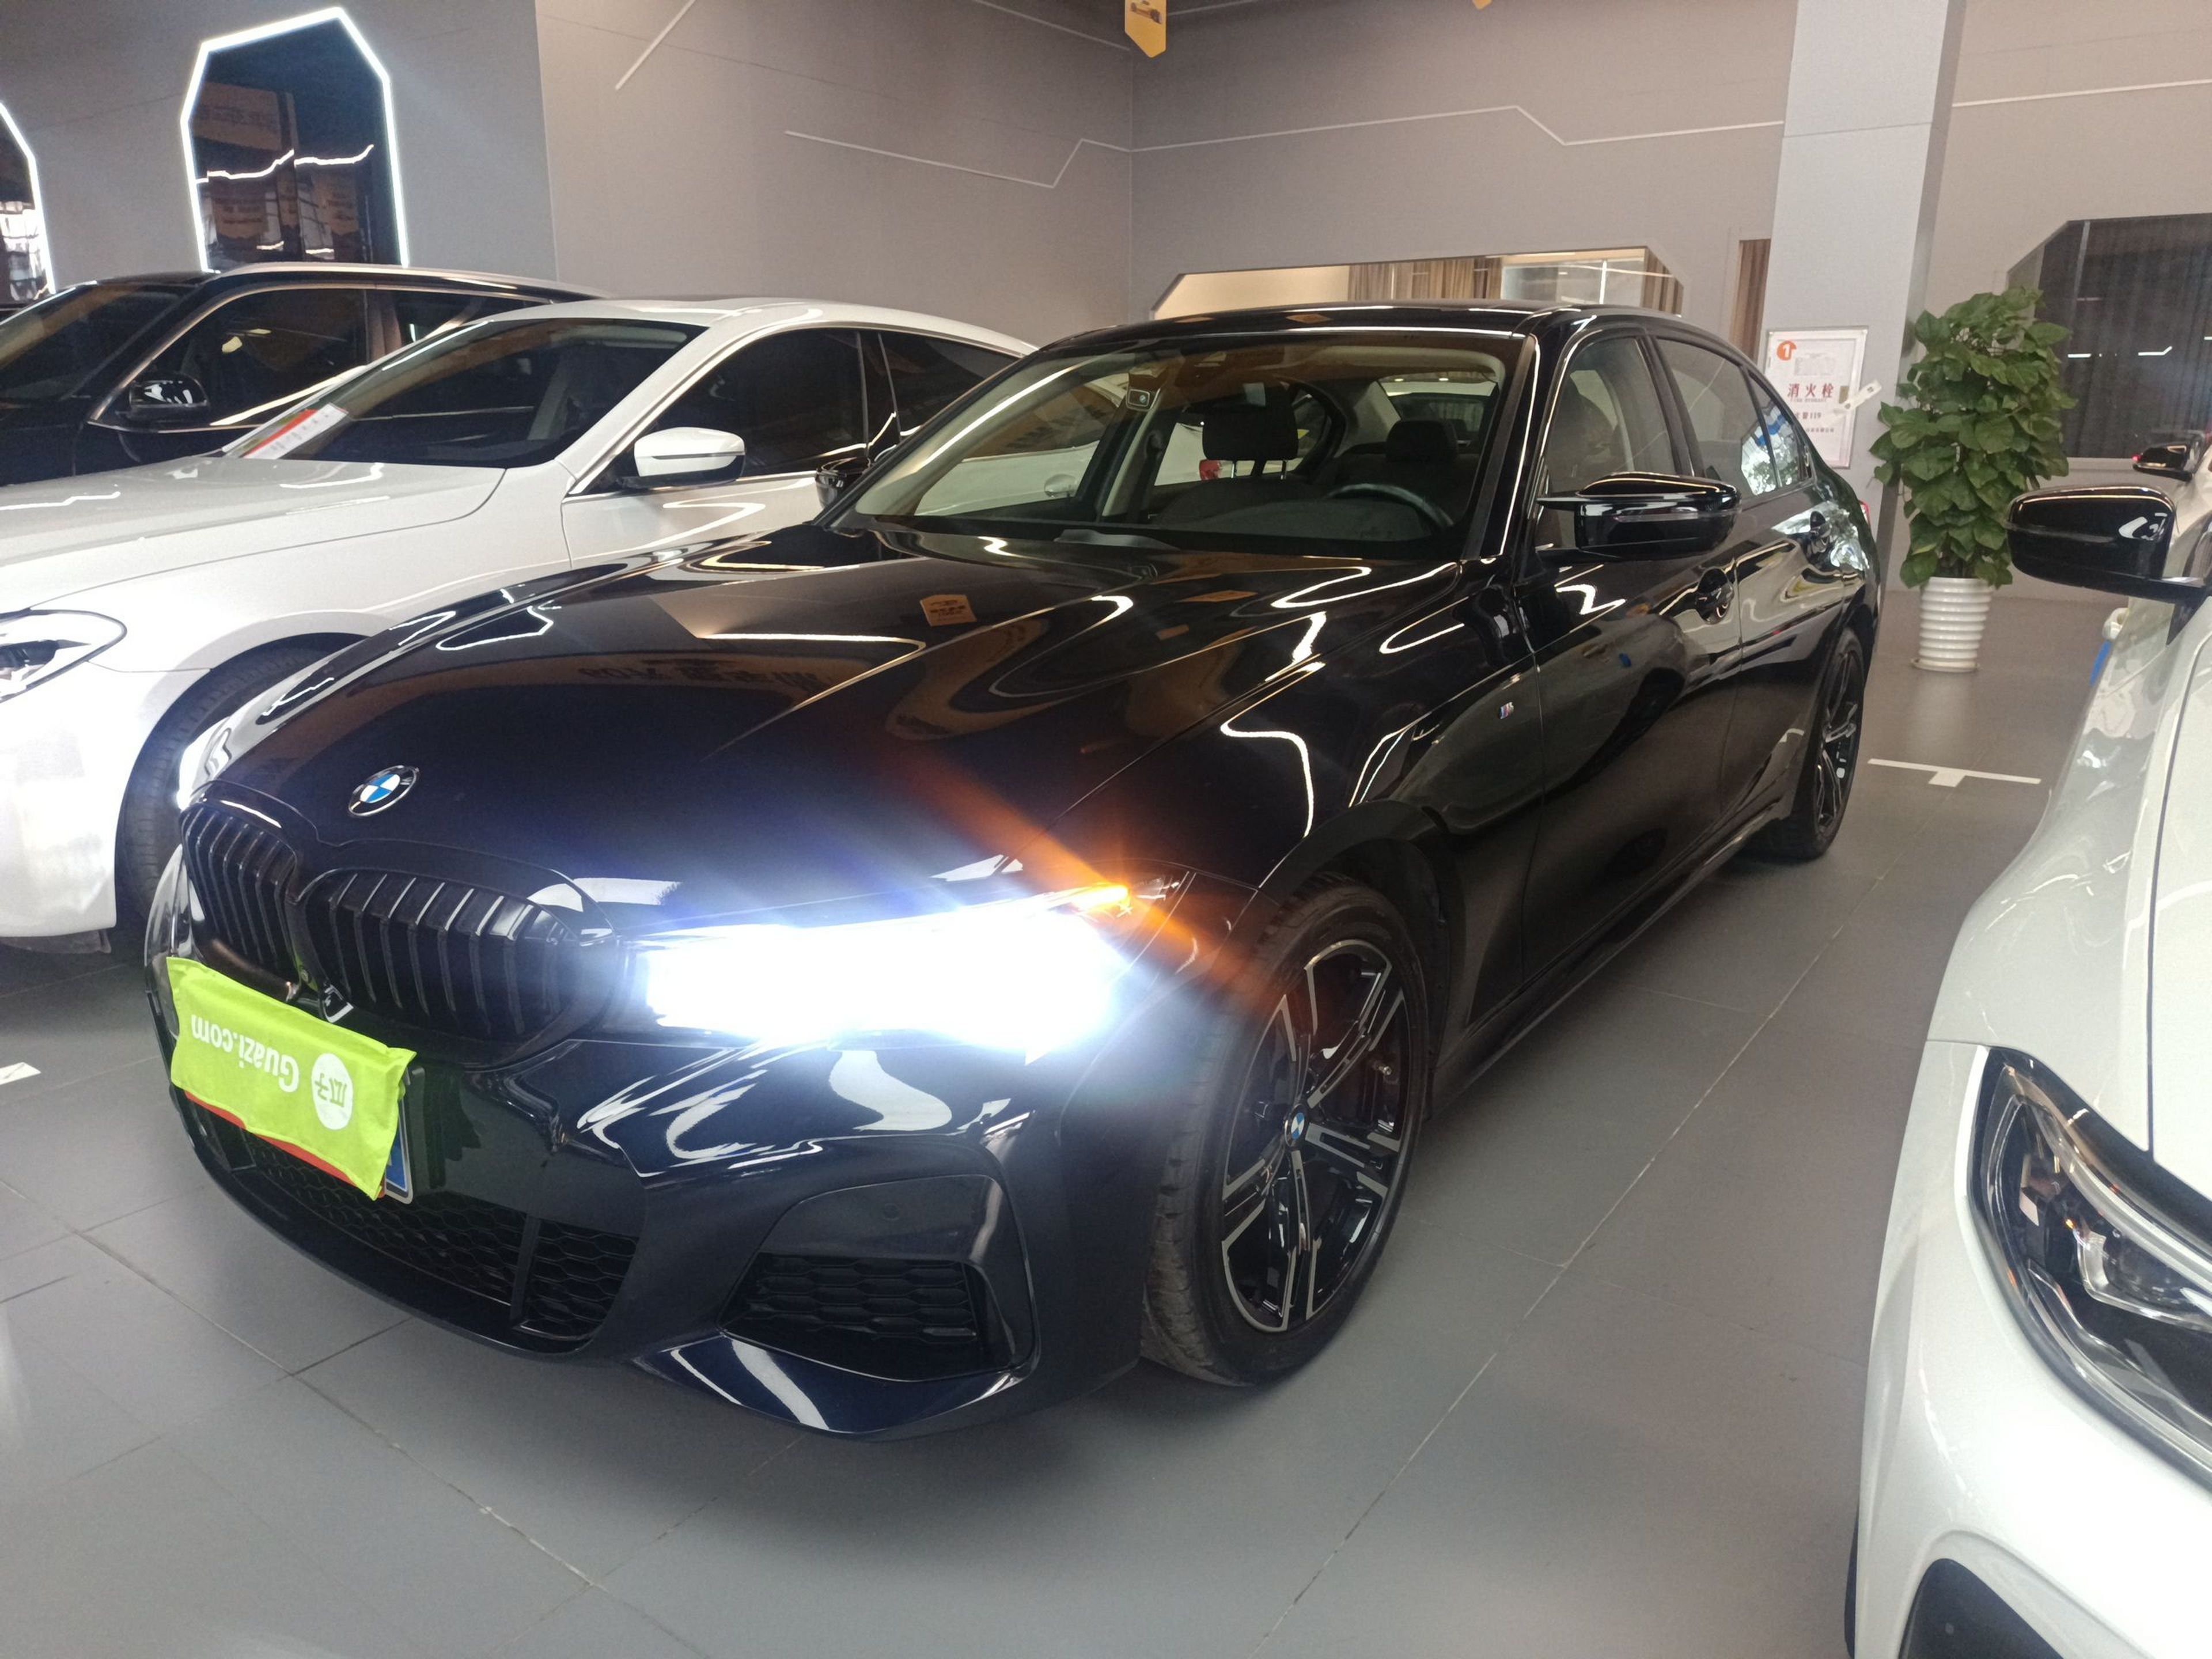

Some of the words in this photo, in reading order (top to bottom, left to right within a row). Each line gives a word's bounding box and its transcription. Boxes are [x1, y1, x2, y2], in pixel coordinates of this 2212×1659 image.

[1783, 344, 1791, 358] 1
[1787, 383, 1834, 398] 消火栓
[191, 1014, 300, 1093] Guazi.com
[315, 1073, 347, 1108] 瓜子
